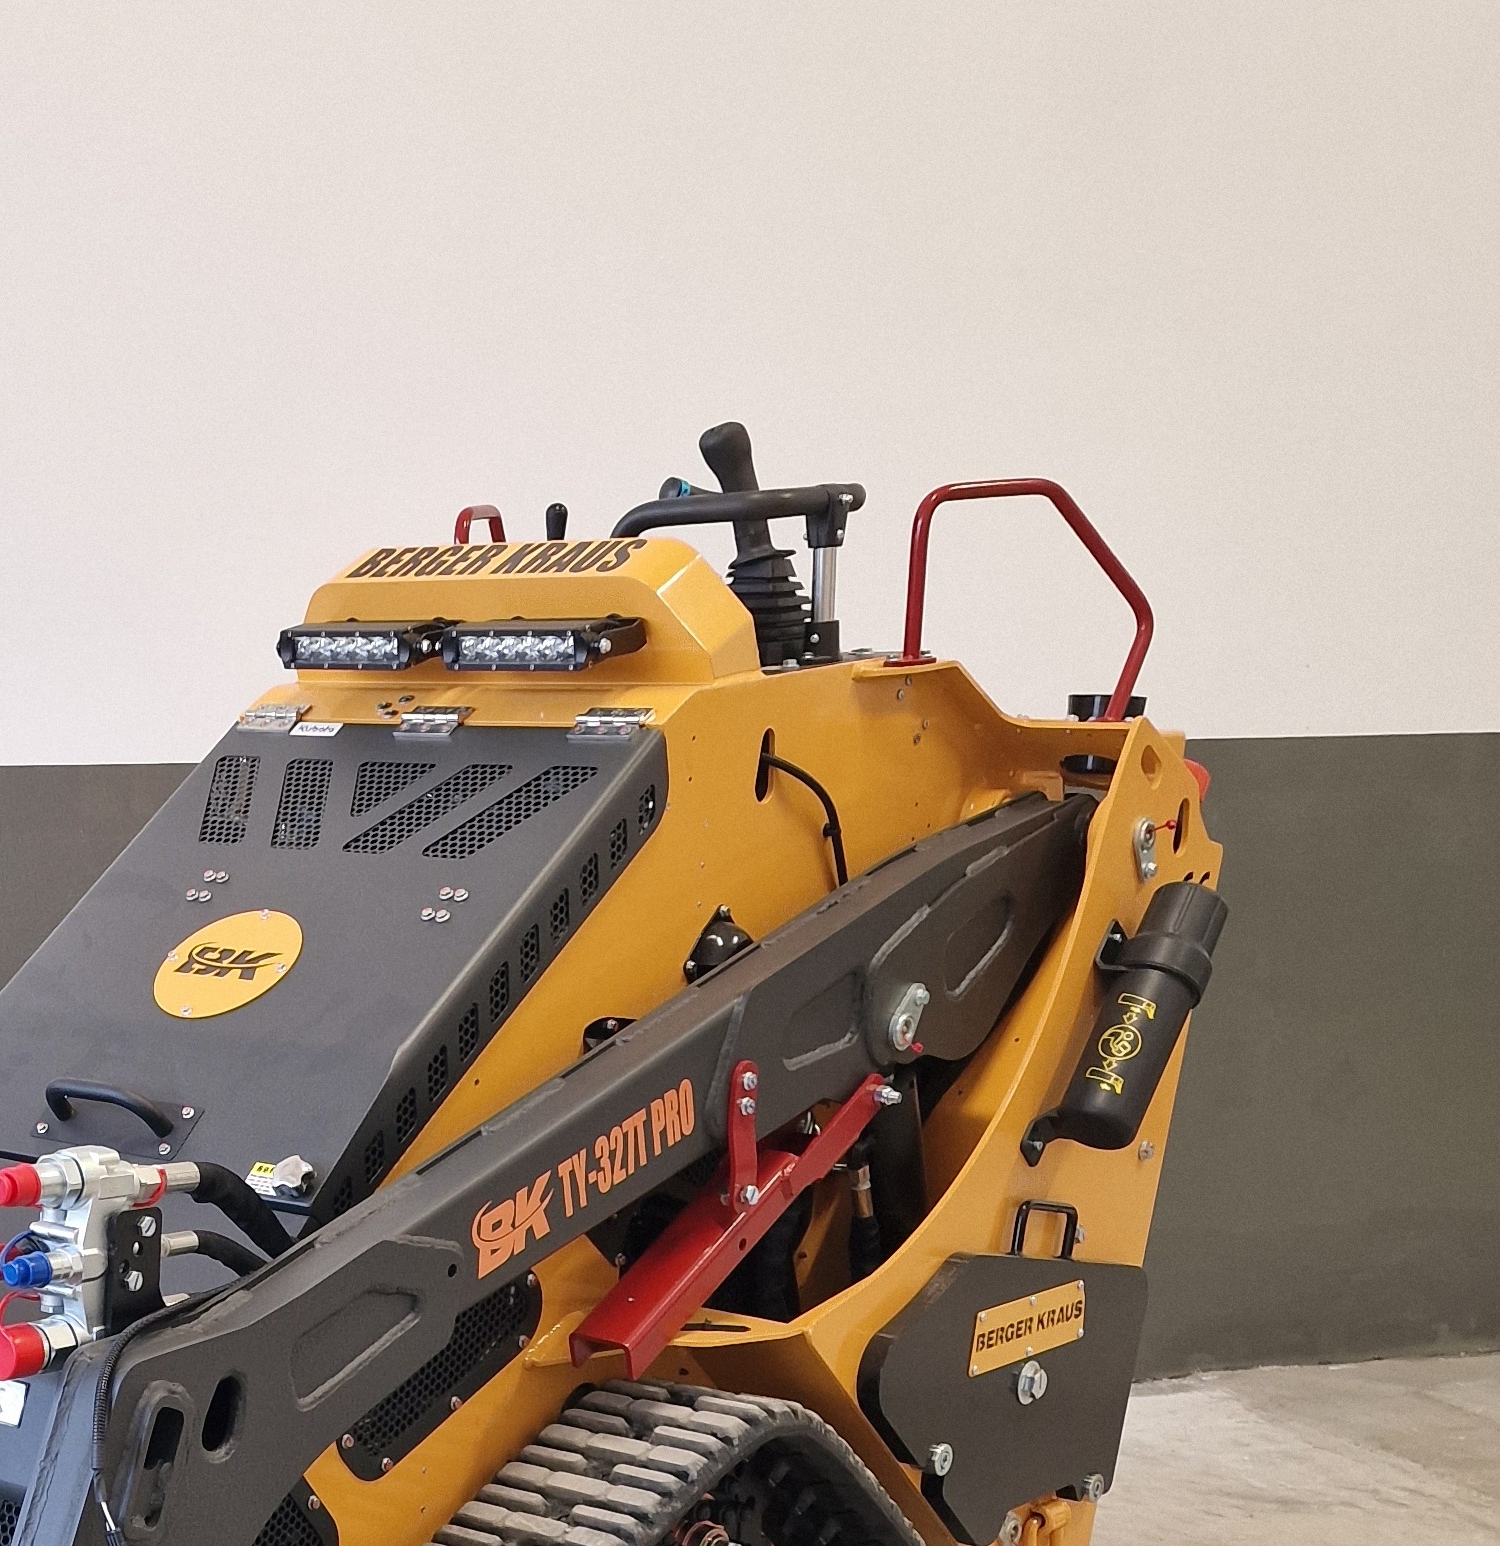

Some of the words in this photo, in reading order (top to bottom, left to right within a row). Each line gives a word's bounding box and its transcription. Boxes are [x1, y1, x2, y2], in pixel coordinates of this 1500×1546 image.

[345, 544, 509, 579] BERGER
[490, 539, 648, 574] KRAUS
[173, 941, 284, 981] BK
[471, 1169, 555, 1280] BK
[650, 1078, 696, 1157] PRO
[975, 1316, 1034, 1353] BERGER
[1036, 1299, 1083, 1332] KRAUS
